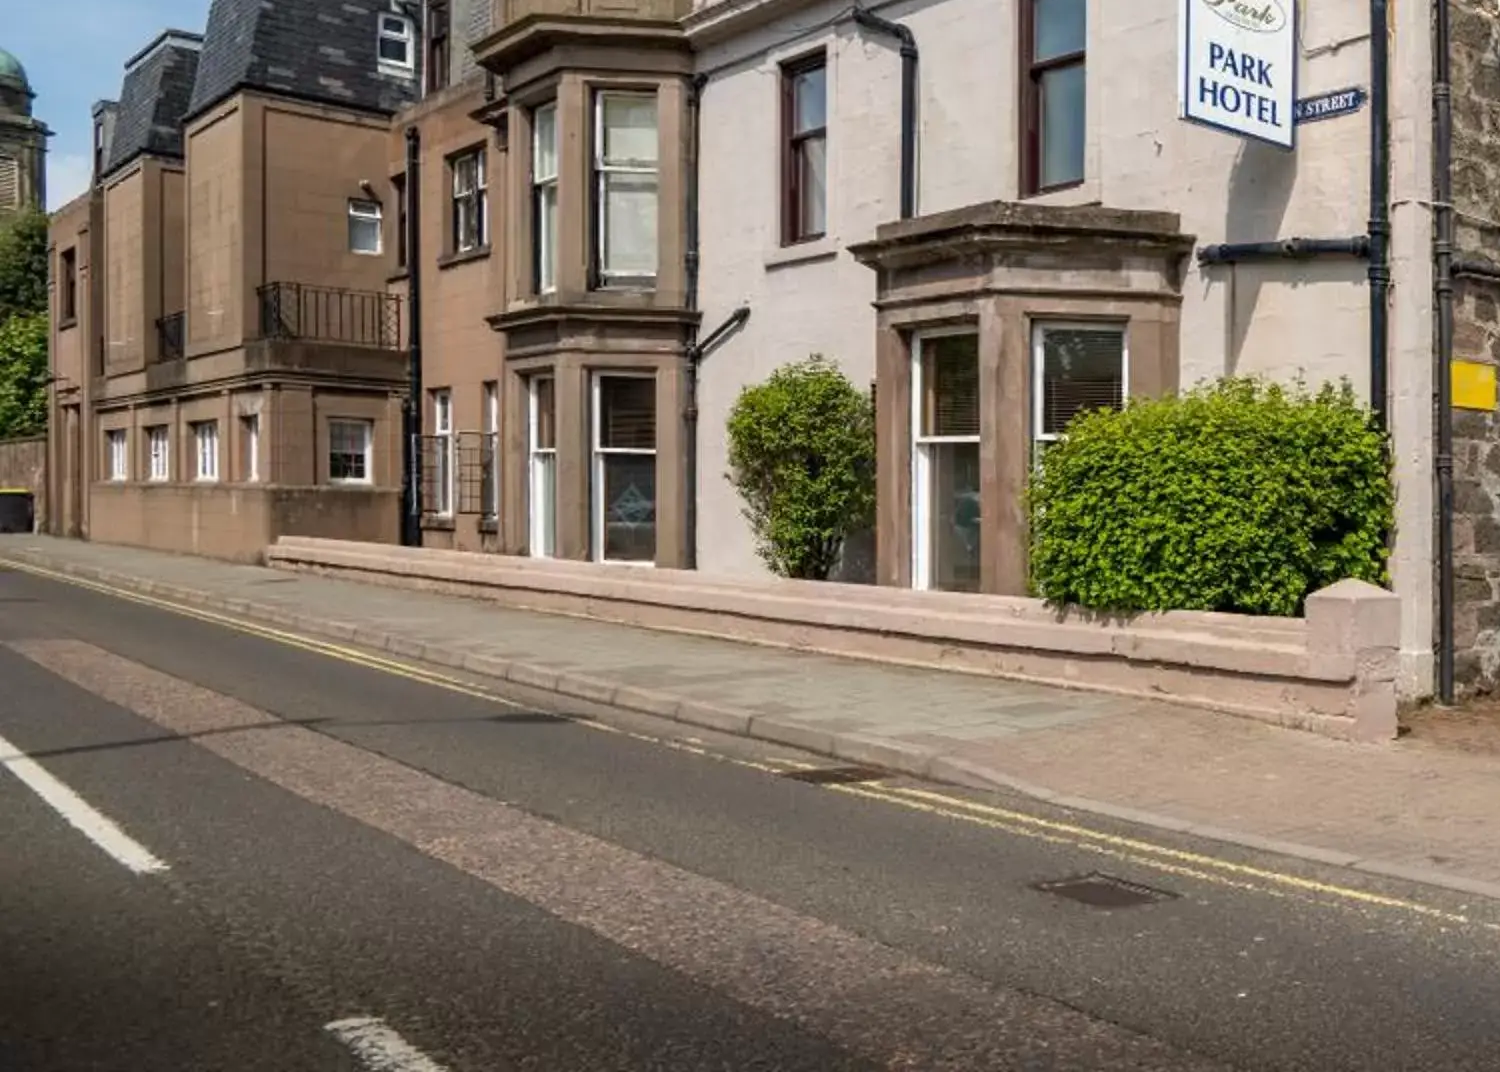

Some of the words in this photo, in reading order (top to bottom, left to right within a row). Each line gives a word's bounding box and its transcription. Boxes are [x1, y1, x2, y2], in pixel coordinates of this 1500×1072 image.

[1208, 42, 1273, 88] PARK
[1199, 77, 1282, 127] HOTEL
[1306, 91, 1356, 116] STREET
